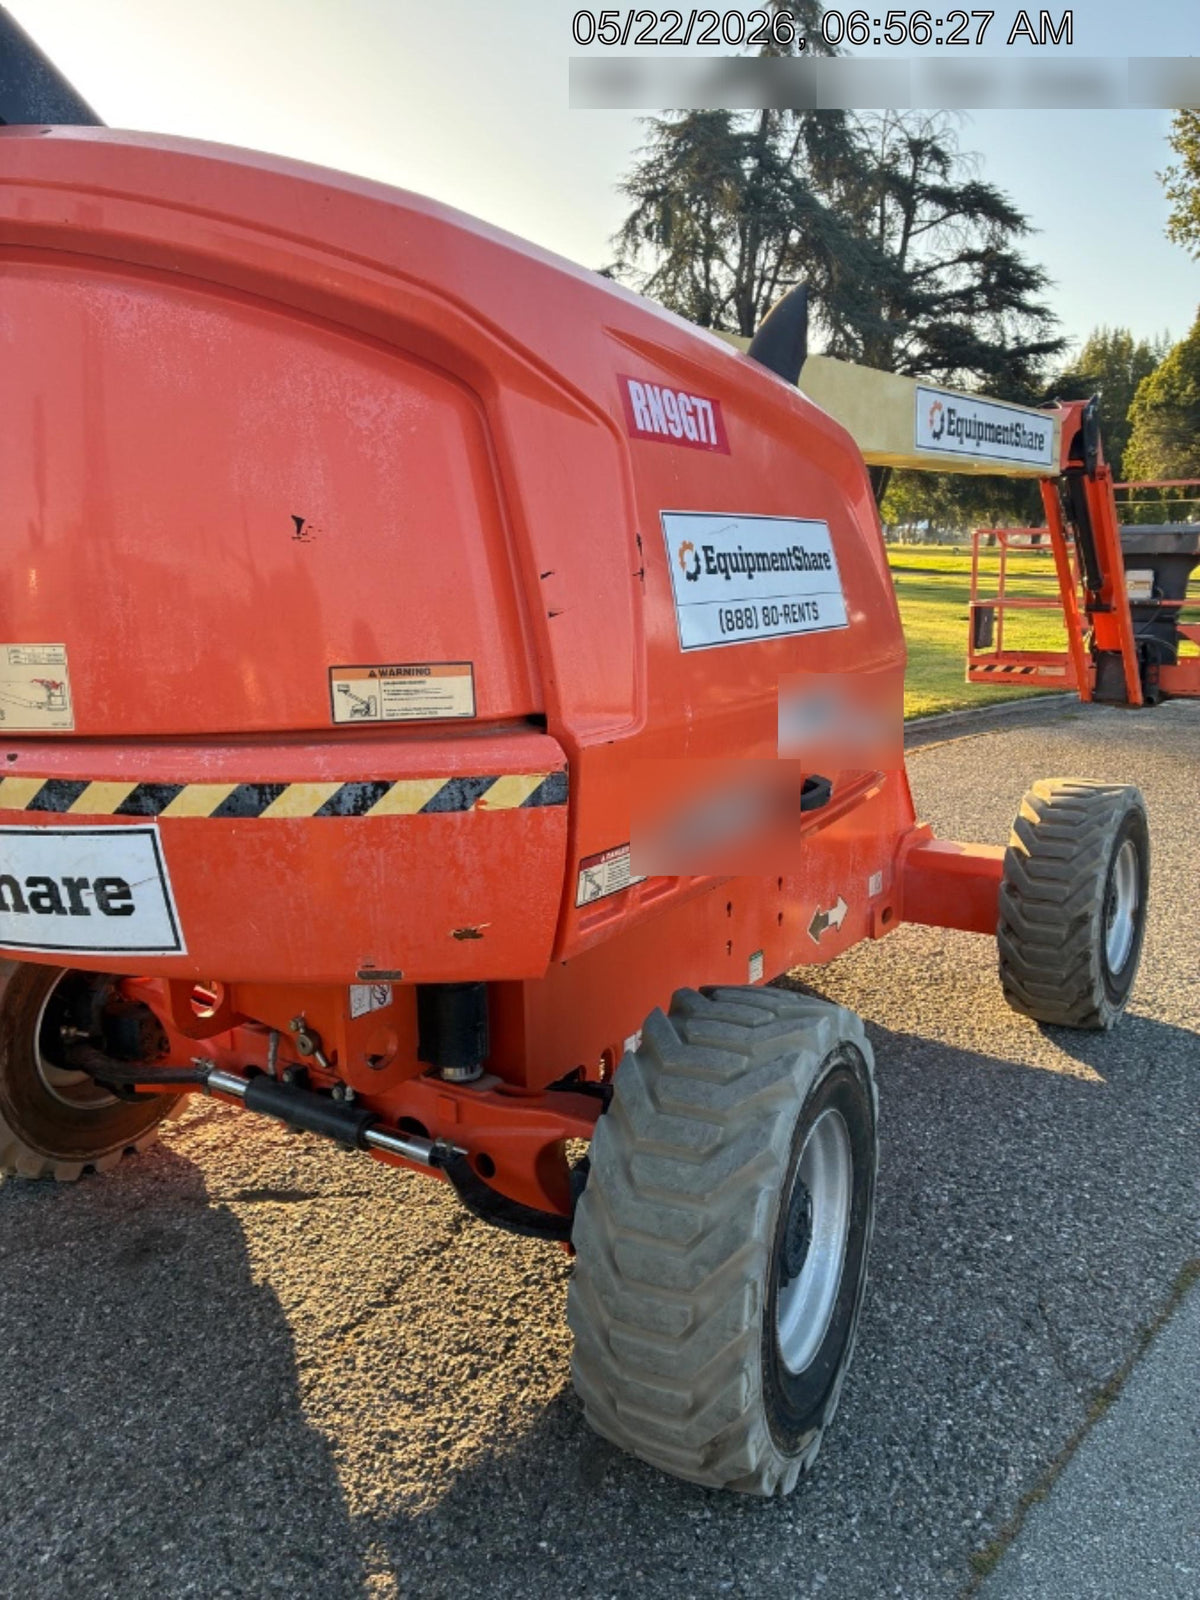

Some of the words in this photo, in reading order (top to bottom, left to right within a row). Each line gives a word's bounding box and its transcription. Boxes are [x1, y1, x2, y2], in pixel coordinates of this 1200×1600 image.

[946, 407, 1045, 451] EquipmentShare
[702, 545, 832, 580] EquipmentShare
[718, 605, 759, 634] (888)
[762, 601, 819, 627] 80-RENTS
[378, 667, 431, 678] WARNING
